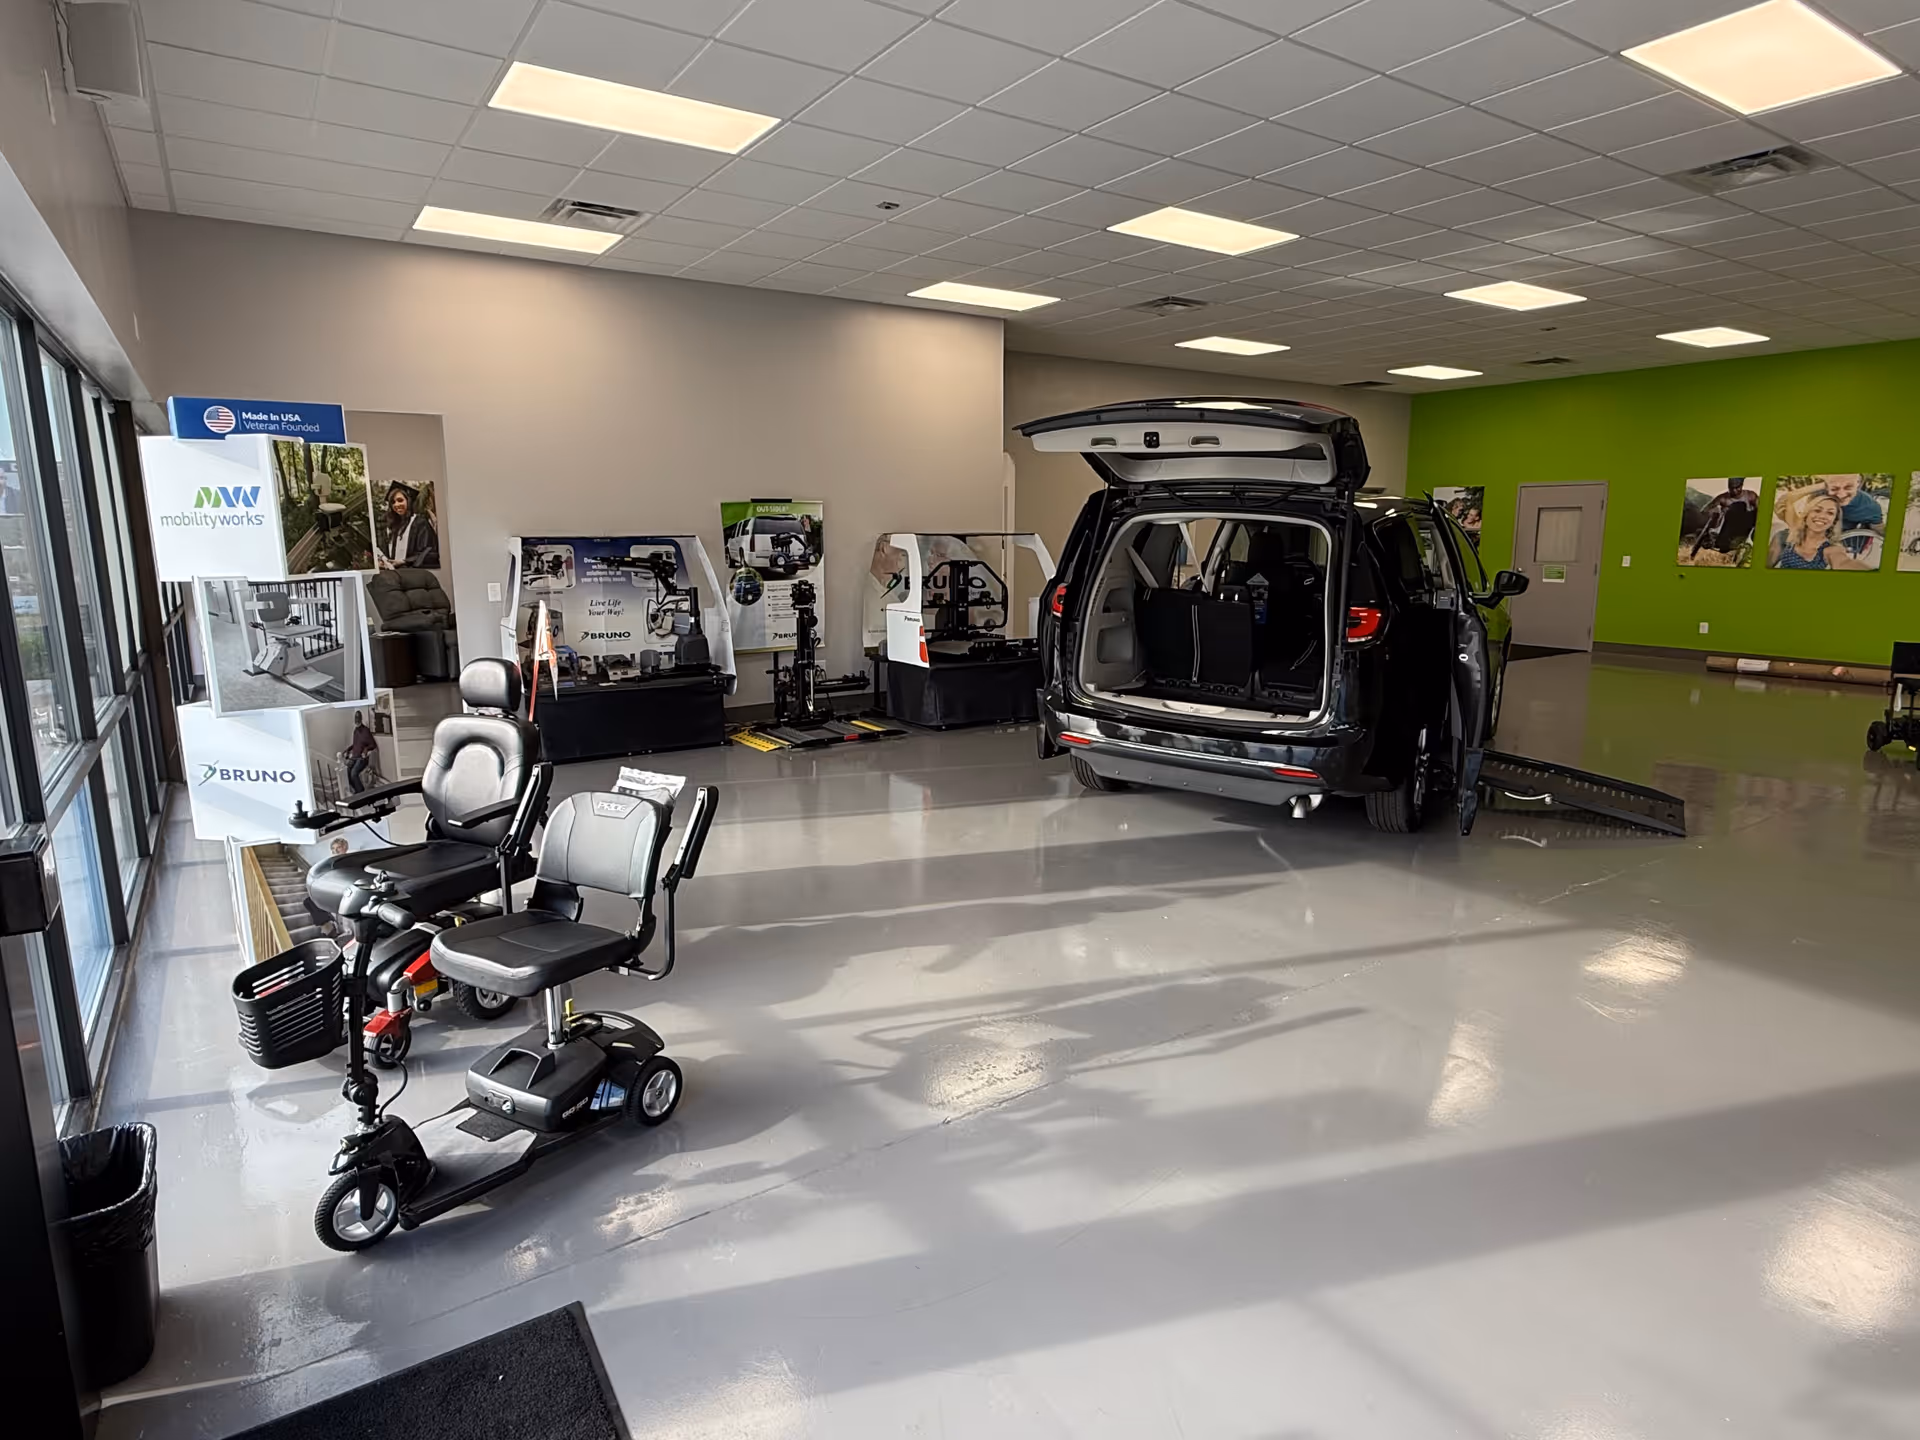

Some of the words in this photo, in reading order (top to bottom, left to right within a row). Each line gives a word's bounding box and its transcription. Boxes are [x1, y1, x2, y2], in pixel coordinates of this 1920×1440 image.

[242, 411, 269, 421] Made
[270, 412, 280, 421] In
[281, 413, 302, 422] USA
[243, 421, 280, 431] Veteran
[281, 422, 320, 432] Founded
[160, 511, 263, 529] mobilityworks
[590, 599, 606, 607] Live
[607, 599, 621, 607] Life
[588, 608, 606, 616] Your
[607, 608, 624, 617] Way!
[590, 631, 631, 640] BRUNO
[219, 769, 296, 783] BRUNO
